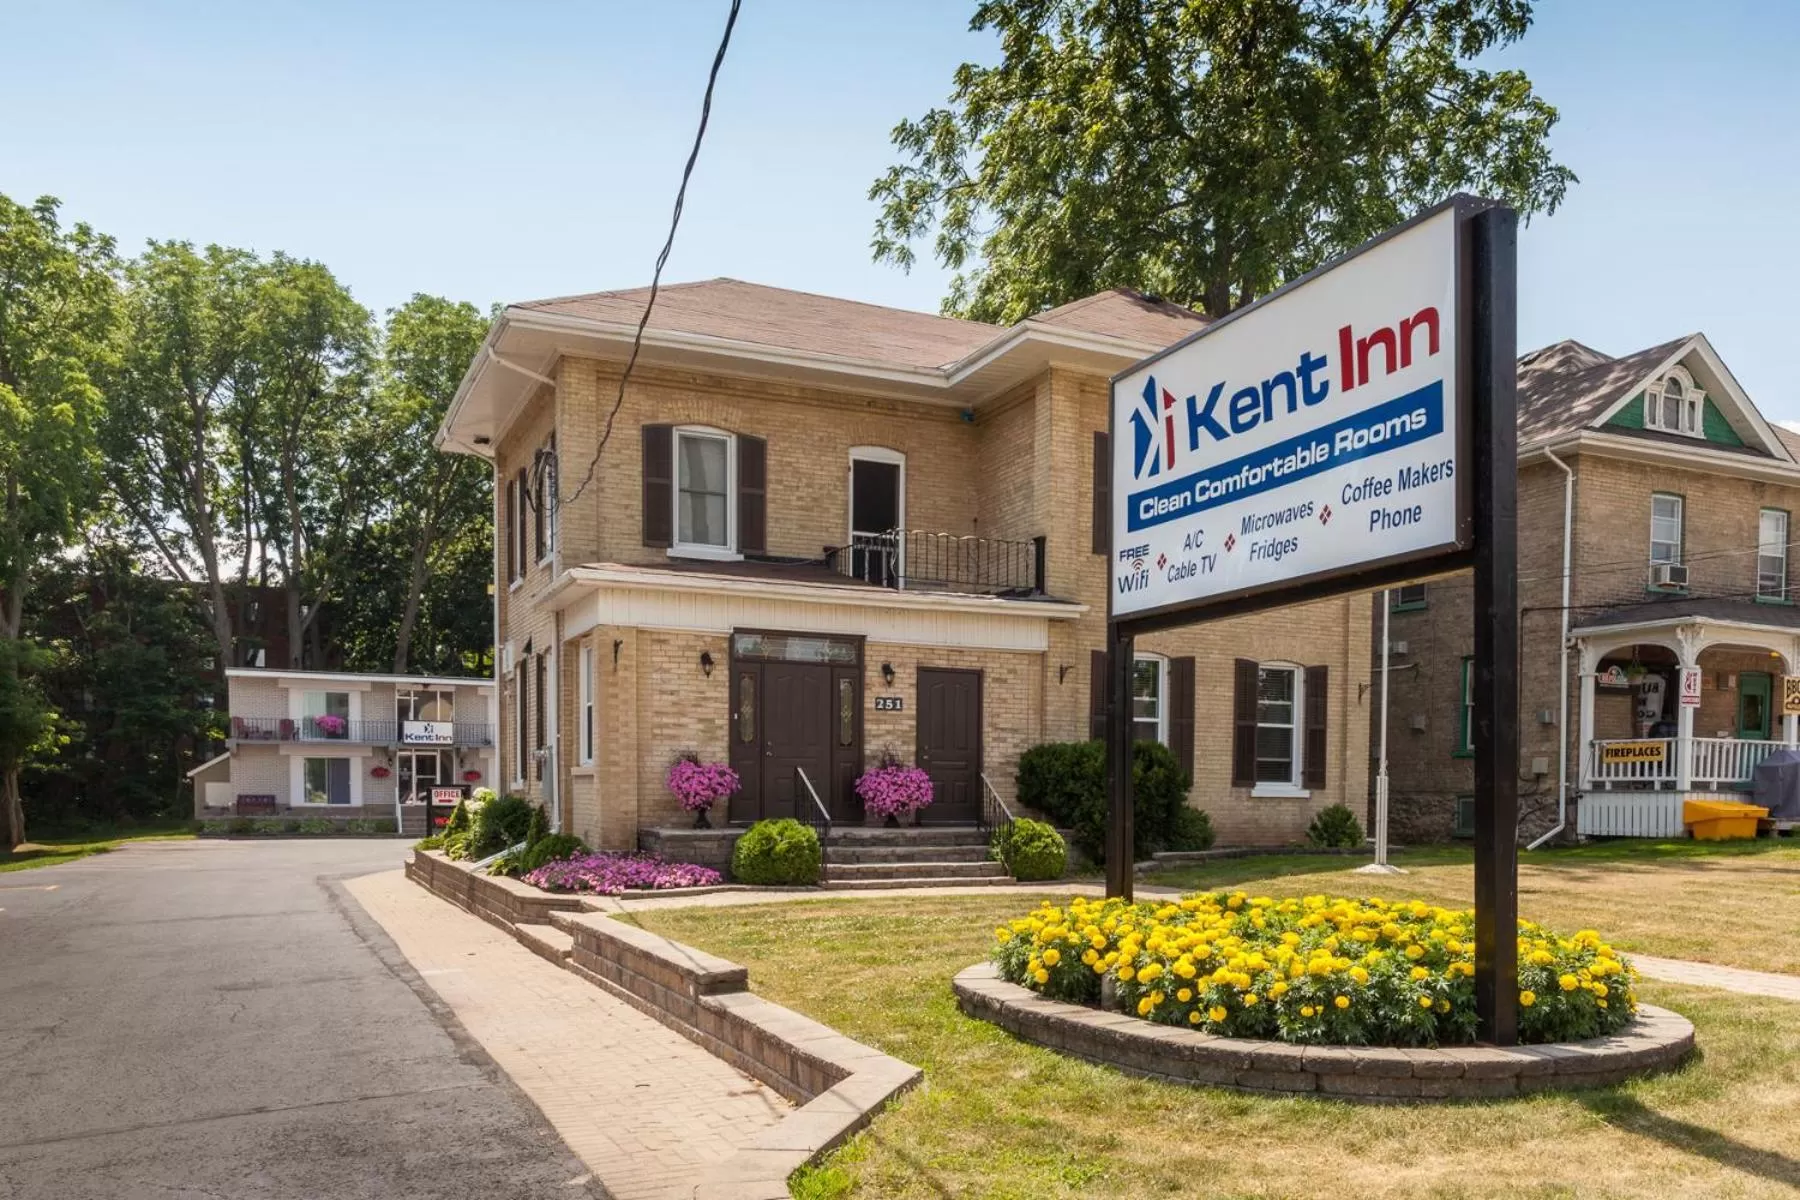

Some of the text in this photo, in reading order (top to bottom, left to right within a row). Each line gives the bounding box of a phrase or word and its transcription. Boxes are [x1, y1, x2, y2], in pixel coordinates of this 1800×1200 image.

[1186, 306, 1440, 452] Kent Inn
[1139, 408, 1427, 520] Clean Comfortable Rooms
[1342, 459, 1454, 505] Coffee Makers
[1240, 500, 1315, 536] Microwaves
[1370, 504, 1422, 532] Phone
[1119, 543, 1150, 562] FREE
[1183, 529, 1204, 551] A/C
[1249, 536, 1298, 562] Fridges
[1167, 553, 1217, 583] Cable TV
[1118, 570, 1149, 594] Wifi
[876, 699, 901, 709] 251
[405, 732, 433, 741] Kent
[1605, 746, 1662, 758] FIREPLACES
[434, 790, 460, 798] OFFICE
